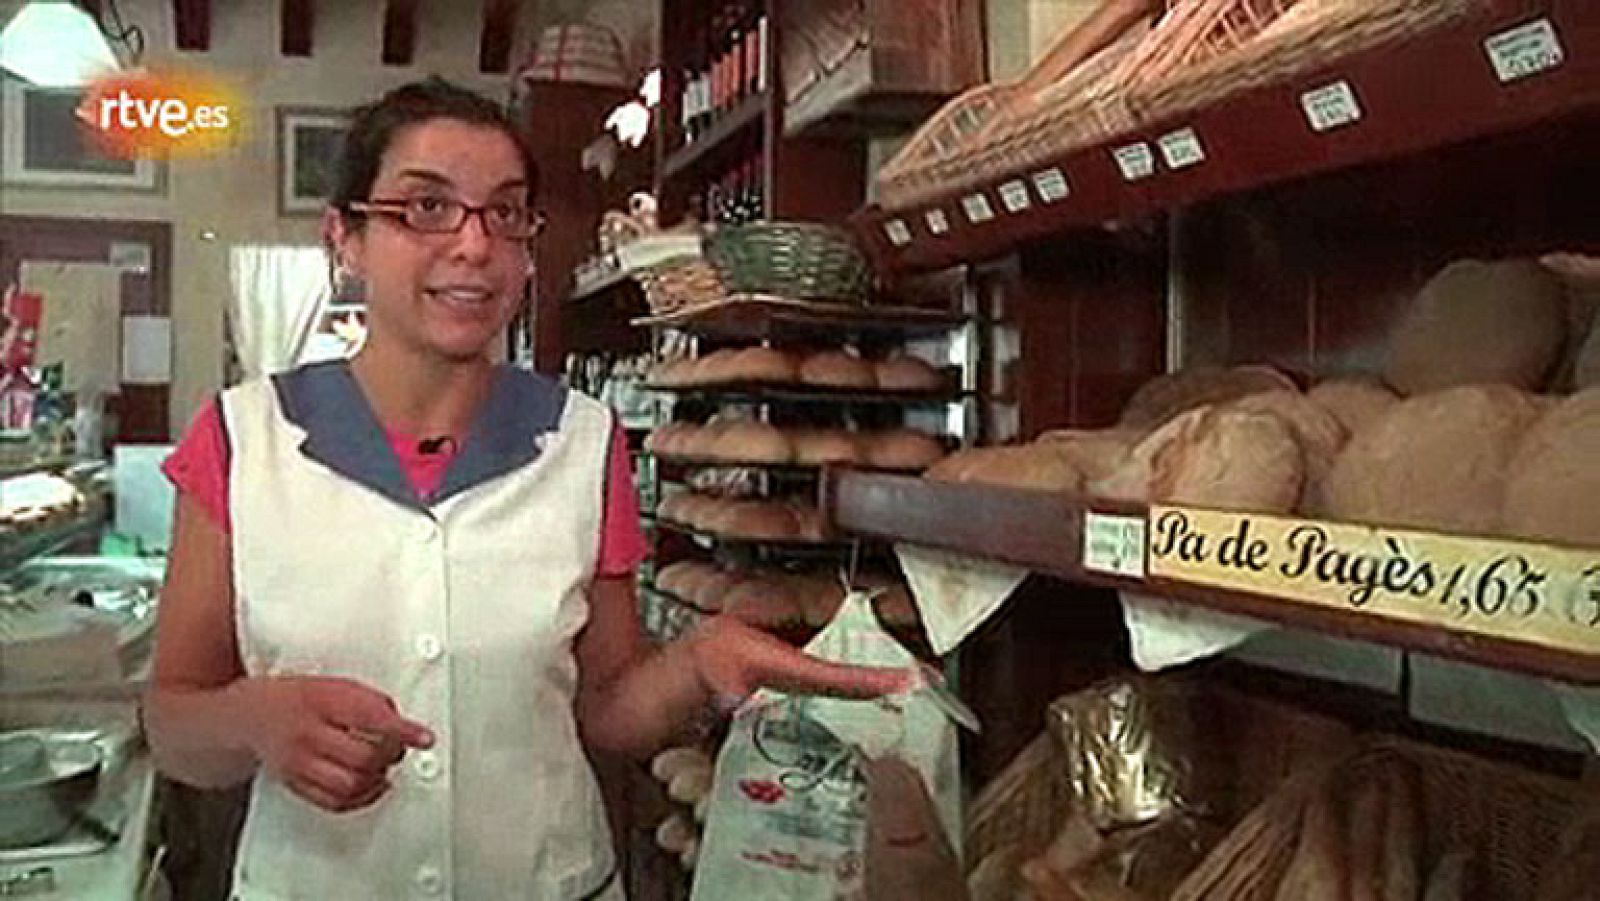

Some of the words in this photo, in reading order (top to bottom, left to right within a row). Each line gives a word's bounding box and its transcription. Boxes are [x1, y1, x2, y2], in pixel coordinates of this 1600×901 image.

[1153, 511, 1211, 562] Pa
[1218, 519, 1269, 572] de
[1280, 525, 1435, 606] Pagès
